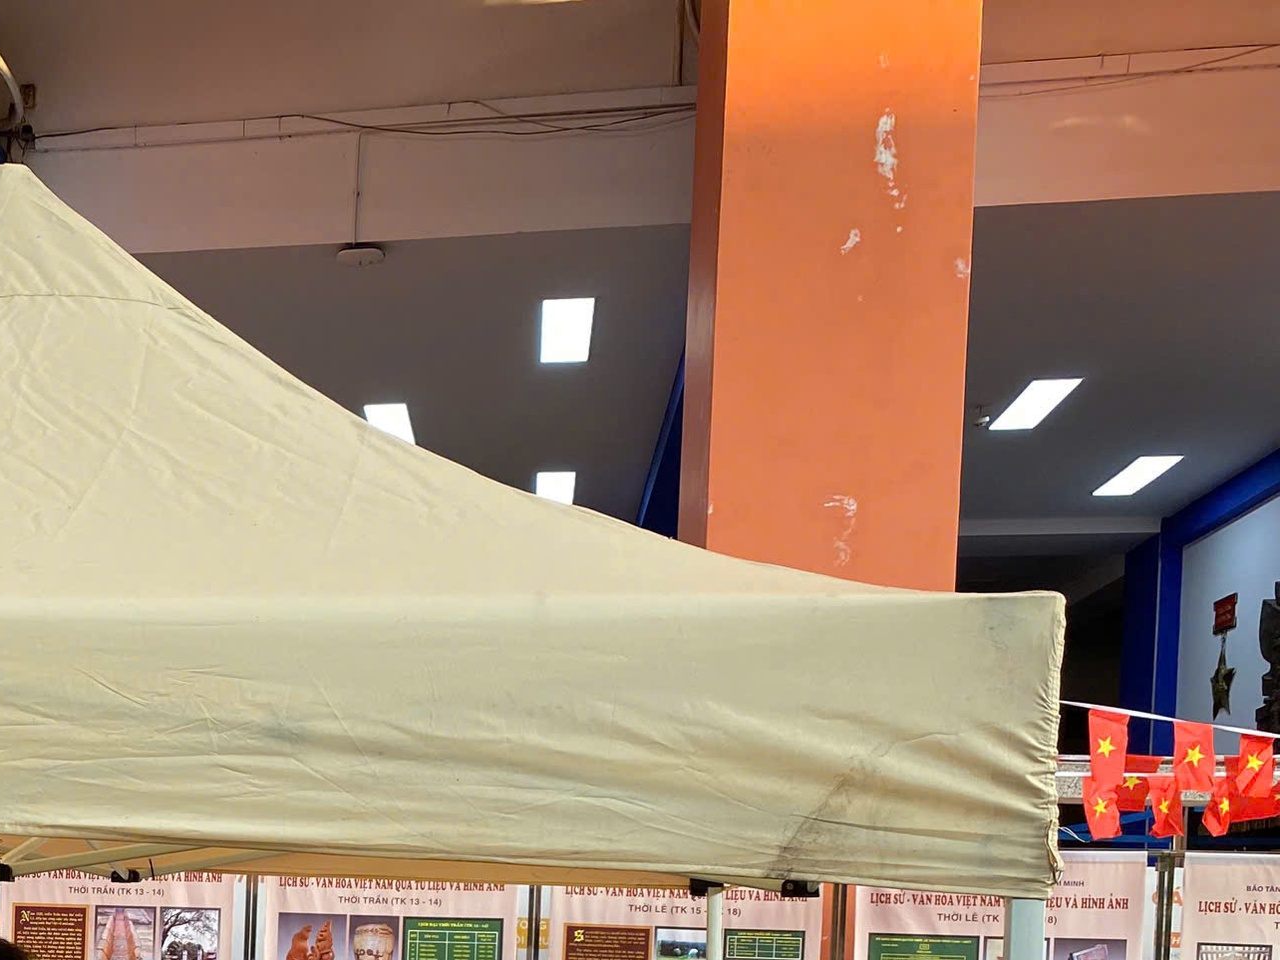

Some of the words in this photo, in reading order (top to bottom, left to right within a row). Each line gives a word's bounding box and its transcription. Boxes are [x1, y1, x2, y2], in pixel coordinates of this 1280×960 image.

[68, 886, 88, 895] THỜI
[93, 886, 115, 896] TRẦN
[118, 888, 132, 897] (TK
[153, 889, 164, 898] 14)
[338, 895, 360, 904] THỜI
[363, 895, 388, 905] TRẦN
[391, 898, 407, 906] (TK
[429, 898, 442, 907] 14)
[870, 892, 892, 906] LỊCH
[893, 890, 906, 905] SỬ
[911, 893, 932, 906] VĂN
[980, 896, 1001, 907] NAM
[1065, 895, 1078, 908] VÀ
[1081, 895, 1105, 910] HÌNH
[1108, 893, 1129, 910] ẢNH
[1198, 901, 1221, 915] LỊCH
[1224, 897, 1238, 913] SỬ
[1244, 900, 1266, 914] VĂN
[628, 904, 652, 913] THỜI
[655, 904, 668, 914] LÊ
[670, 906, 687, 915] (TK
[691, 907, 701, 915] 15
[727, 907, 741, 917] 18)
[937, 912, 962, 921] THỜI
[965, 911, 978, 922] LÊ
[981, 913, 999, 923] (TK
